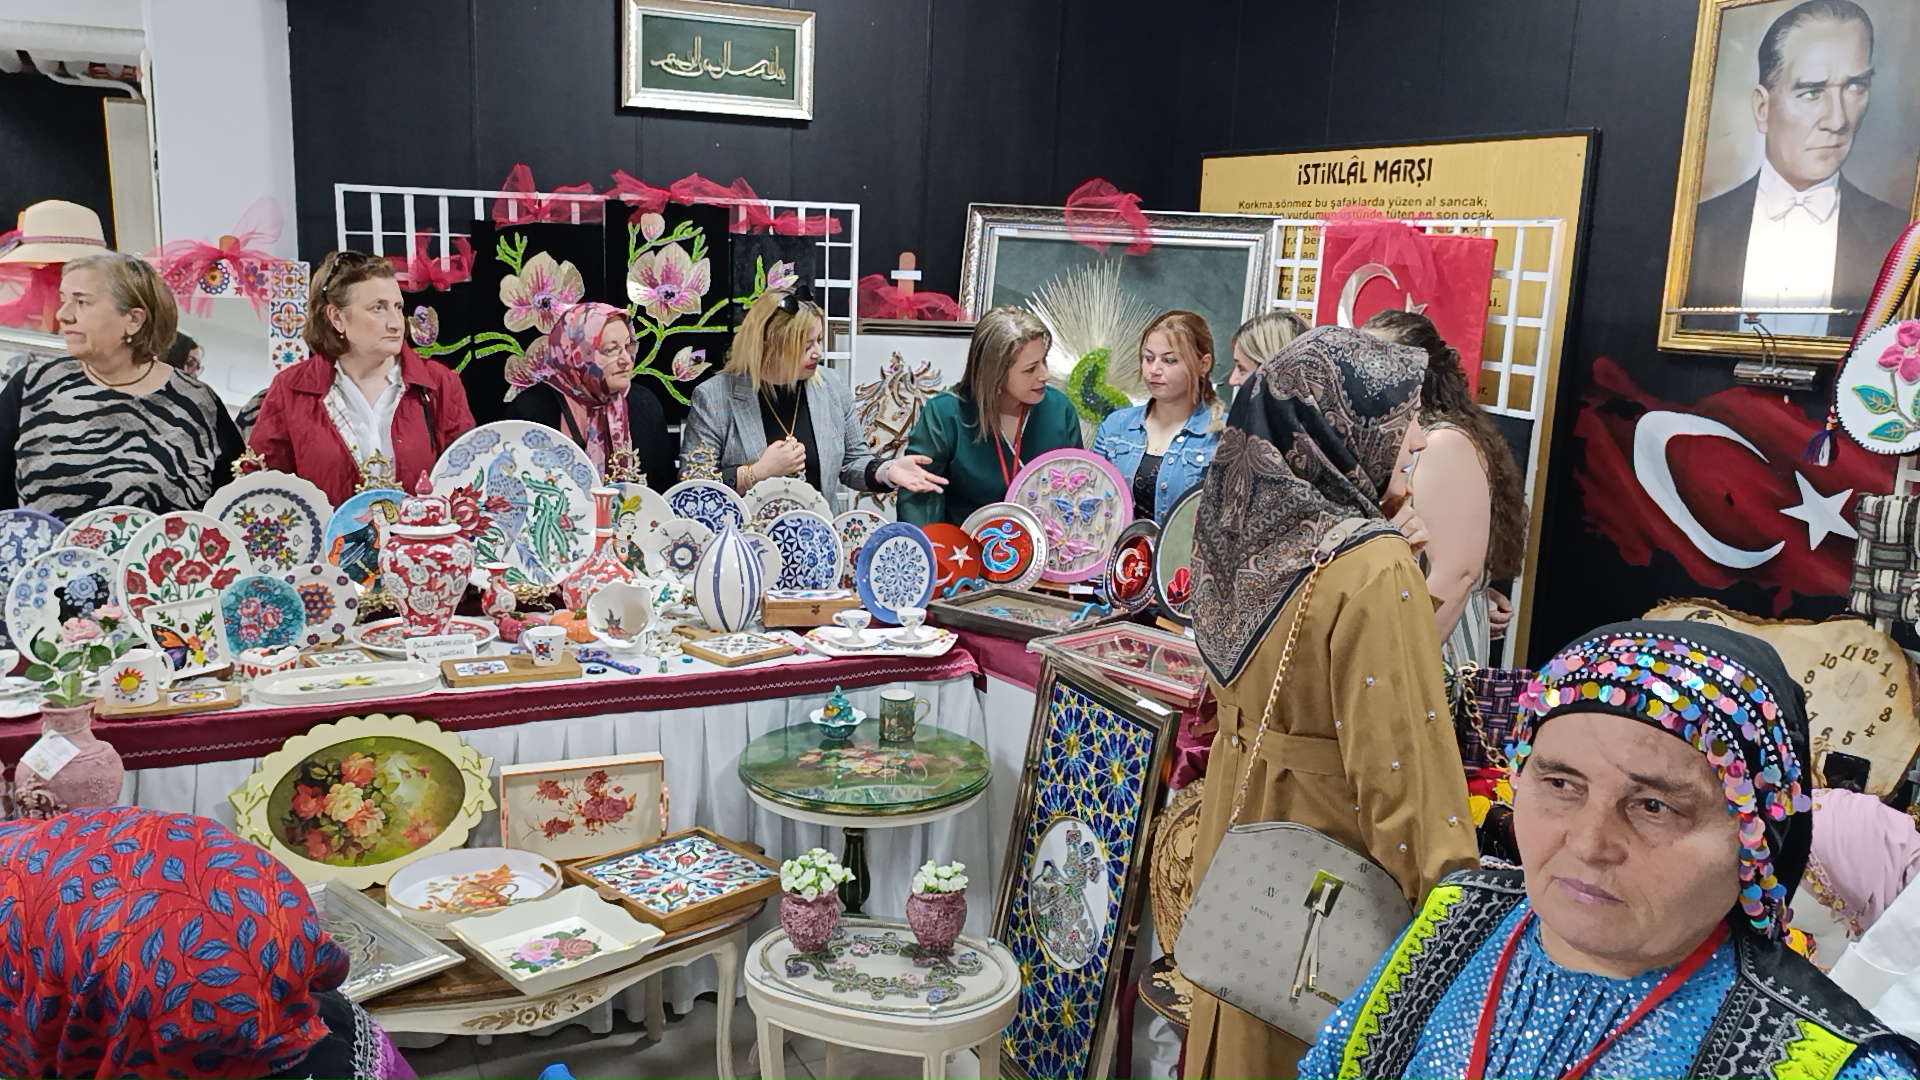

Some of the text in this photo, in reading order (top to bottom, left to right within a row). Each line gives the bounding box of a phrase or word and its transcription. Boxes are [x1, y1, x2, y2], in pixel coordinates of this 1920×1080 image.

[1373, 158, 1433, 188] MARŞI
[1315, 198, 1328, 208] bu
[1330, 197, 1385, 209] şafaklarda
[1388, 196, 1422, 209] yüzen
[1425, 196, 1436, 207] al
[1439, 196, 1488, 208] sancak;
[1386, 209, 1415, 219] tüten
[1436, 210, 1459, 219] son
[1820, 653, 1837, 669] 10
[1840, 645, 1859, 662] 11
[1862, 647, 1880, 665] 12
[1804, 670, 1815, 684] 9
[1879, 662, 1892, 677] 1
[1842, 731, 1856, 745] 5
[1864, 723, 1876, 738] 4
